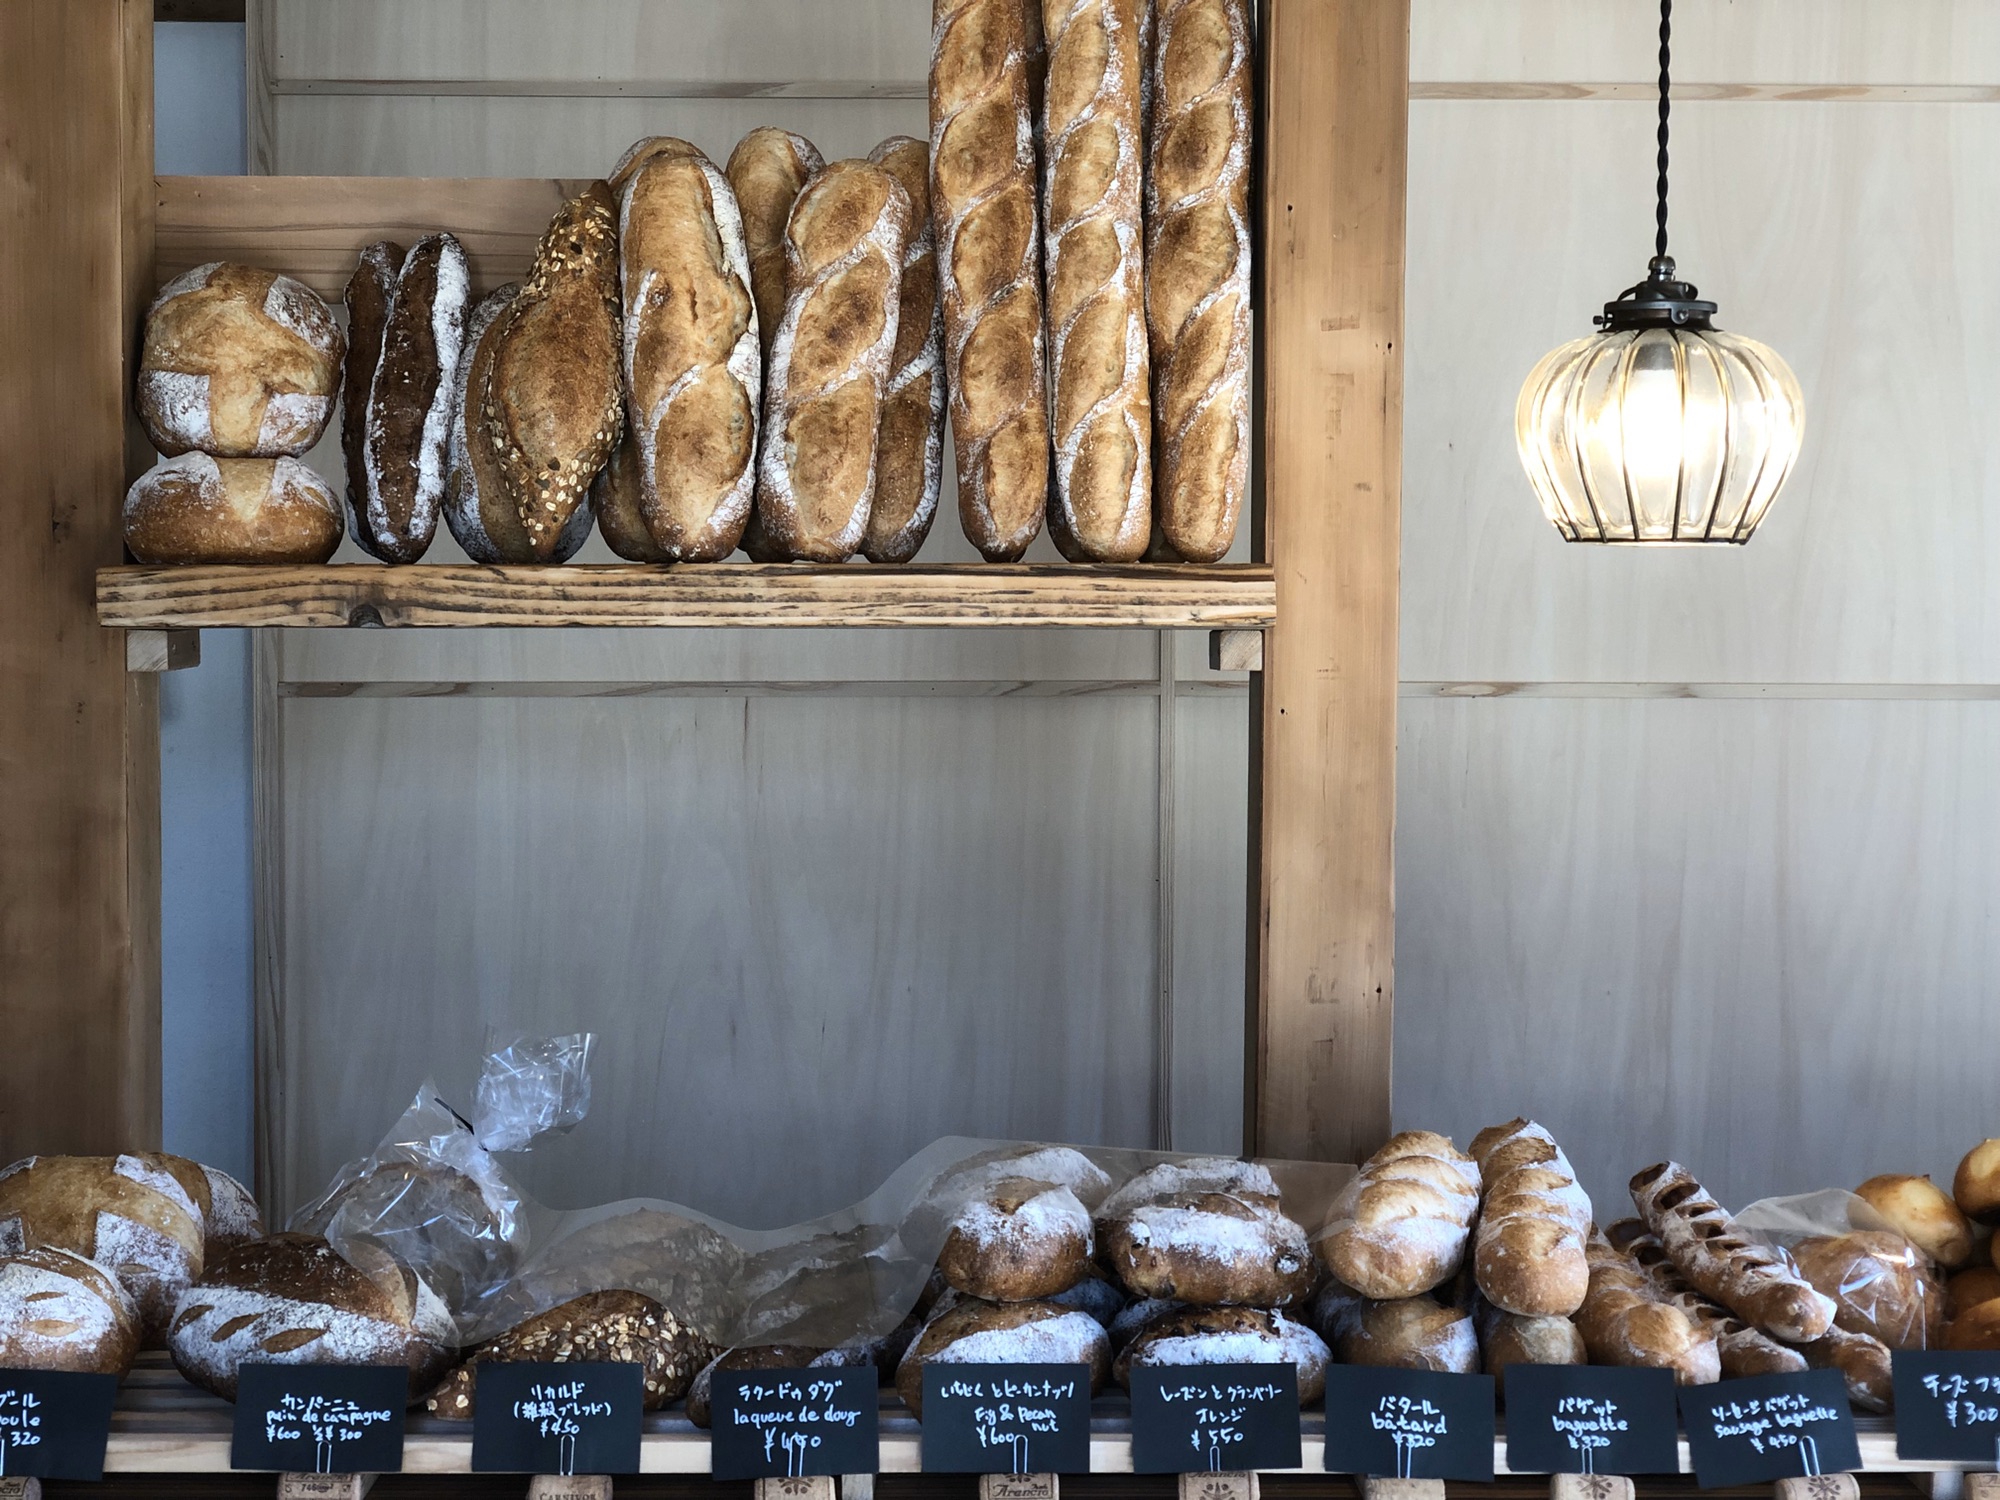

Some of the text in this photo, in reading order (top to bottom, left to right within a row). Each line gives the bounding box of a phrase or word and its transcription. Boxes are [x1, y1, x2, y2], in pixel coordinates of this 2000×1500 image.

[530, 1381, 586, 1401] リカルド
[280, 1393, 360, 1412] カンパーニュ
[999, 1403, 1015, 1421] &
[1379, 1396, 1441, 1416] バタール
[1558, 1396, 1618, 1417] バゲット
[0, 1409, 41, 1428] oule
[301, 1408, 320, 1423] de
[322, 1410, 392, 1426] campagne
[798, 1405, 820, 1422] de
[1195, 1406, 1247, 1424] オレンジ
[1775, 1406, 1839, 1428] baguette
[1031, 1418, 1060, 1432] nut
[1551, 1414, 1629, 1437] baguette
